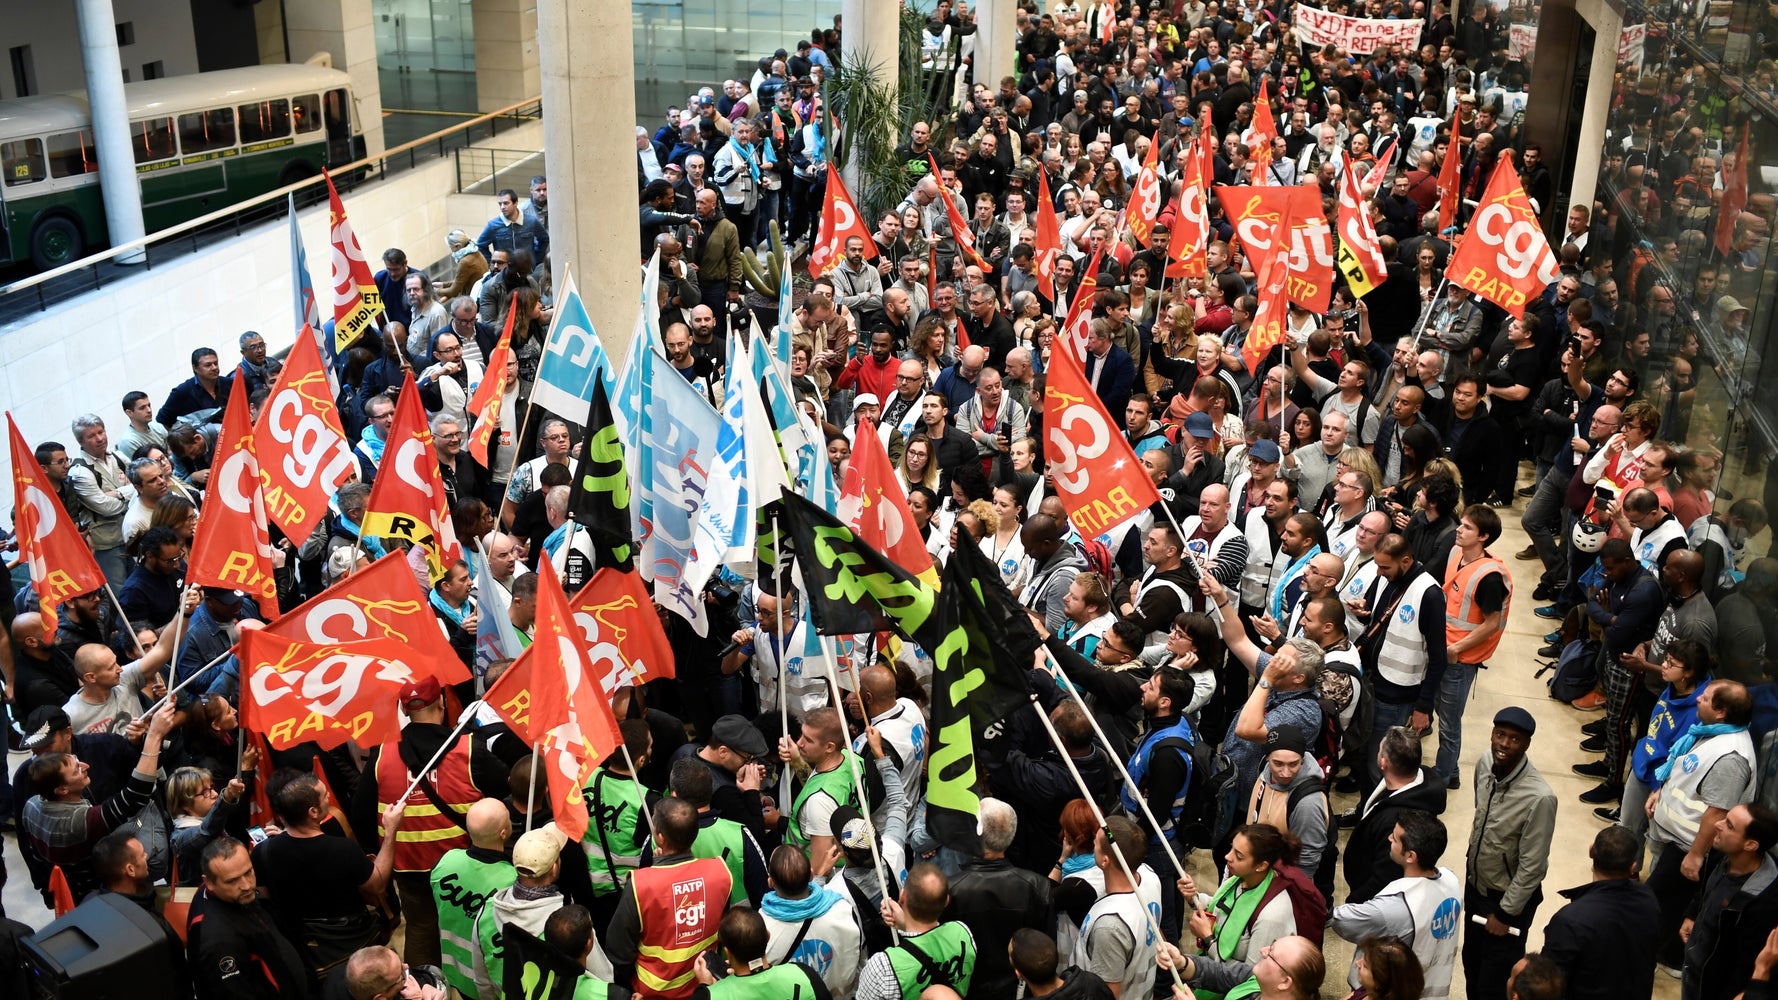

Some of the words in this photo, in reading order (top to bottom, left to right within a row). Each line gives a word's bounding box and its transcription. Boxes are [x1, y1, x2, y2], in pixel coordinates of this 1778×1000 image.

[1313, 11, 1357, 36] VDF
[15, 164, 29, 177] 129
[1463, 266, 1526, 308] RATP
[674, 880, 703, 896] RATP
[675, 900, 706, 927] cgt
